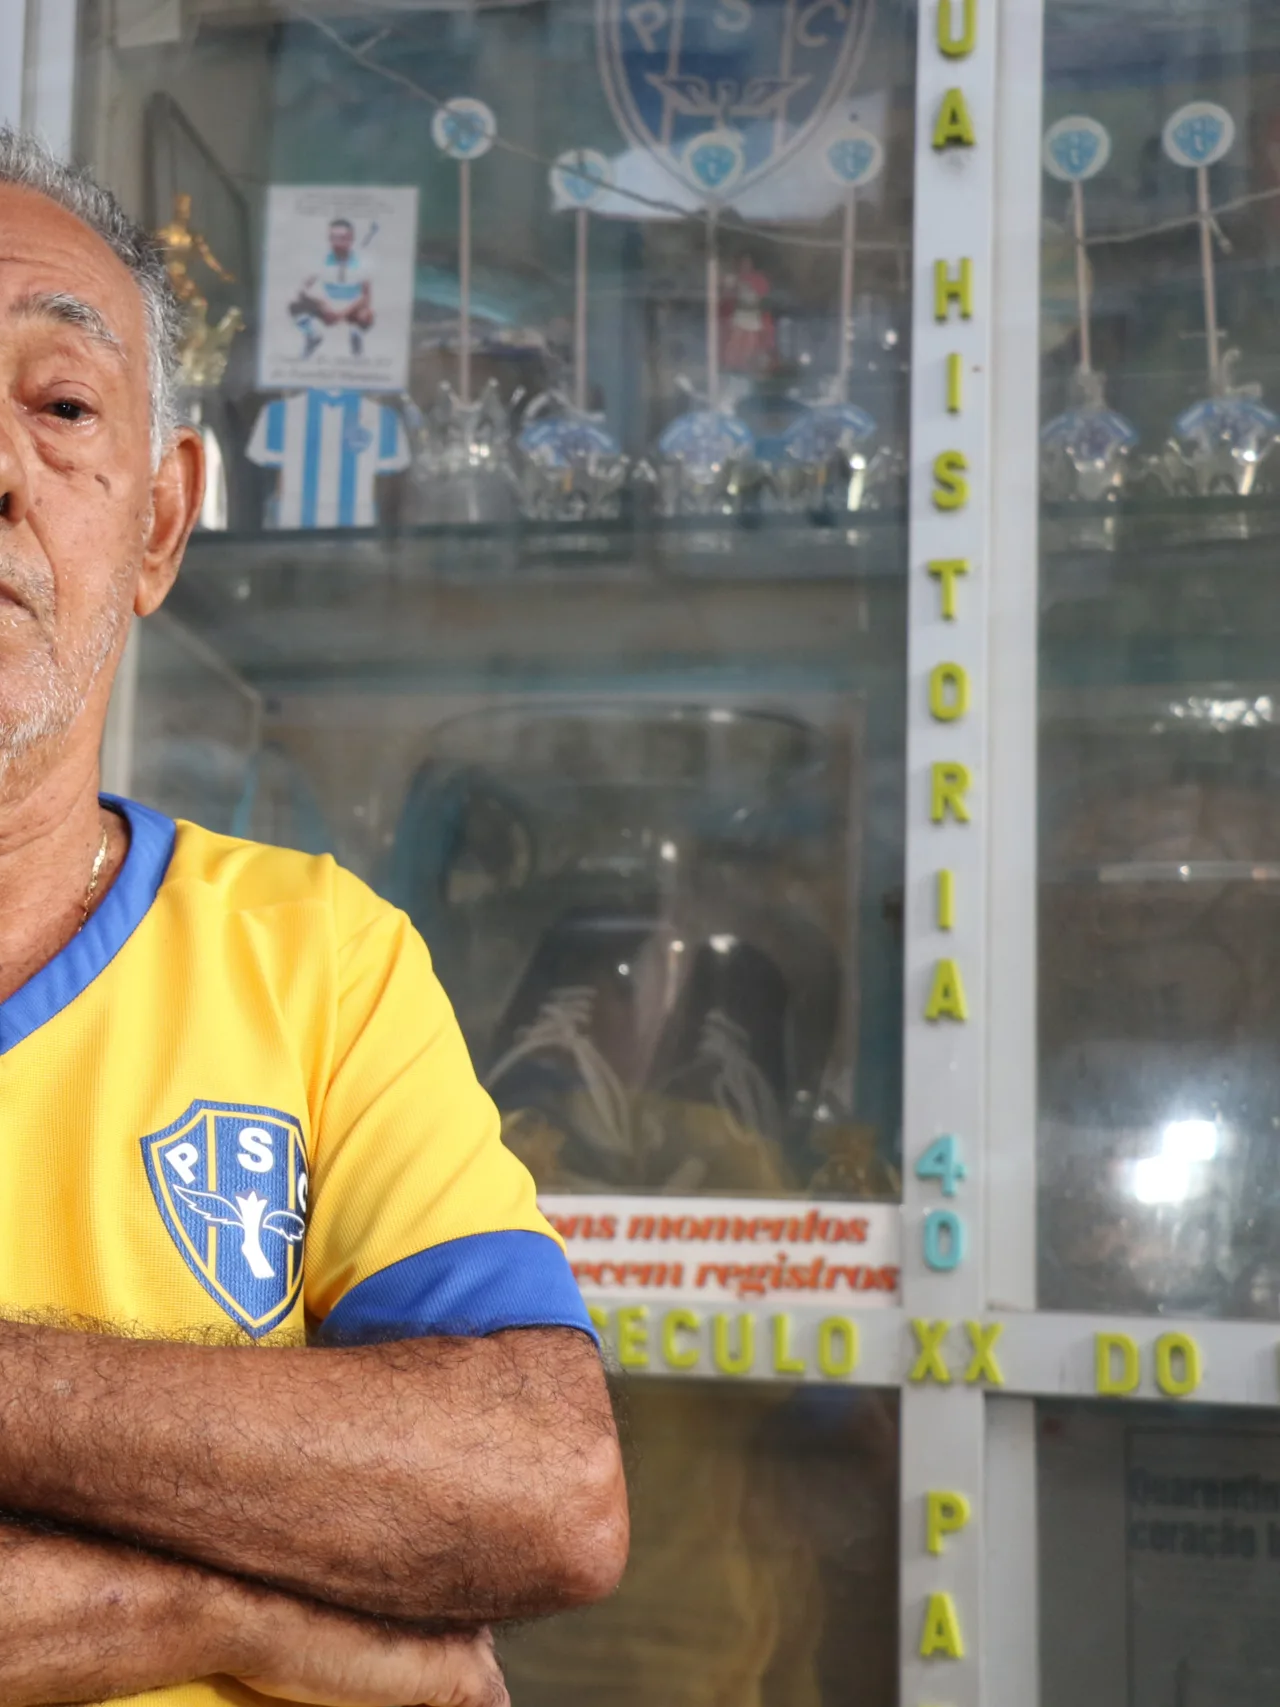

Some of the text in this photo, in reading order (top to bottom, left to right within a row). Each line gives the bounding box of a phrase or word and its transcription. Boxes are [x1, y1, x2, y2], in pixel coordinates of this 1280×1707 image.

[926, 256, 973, 1023] HISTORIA
[627, 1205, 868, 1243] momentos
[914, 1134, 966, 1271] 40
[696, 1251, 900, 1300] registros
[909, 1317, 1005, 1386] XX
[1094, 1331, 1202, 1397] DO
